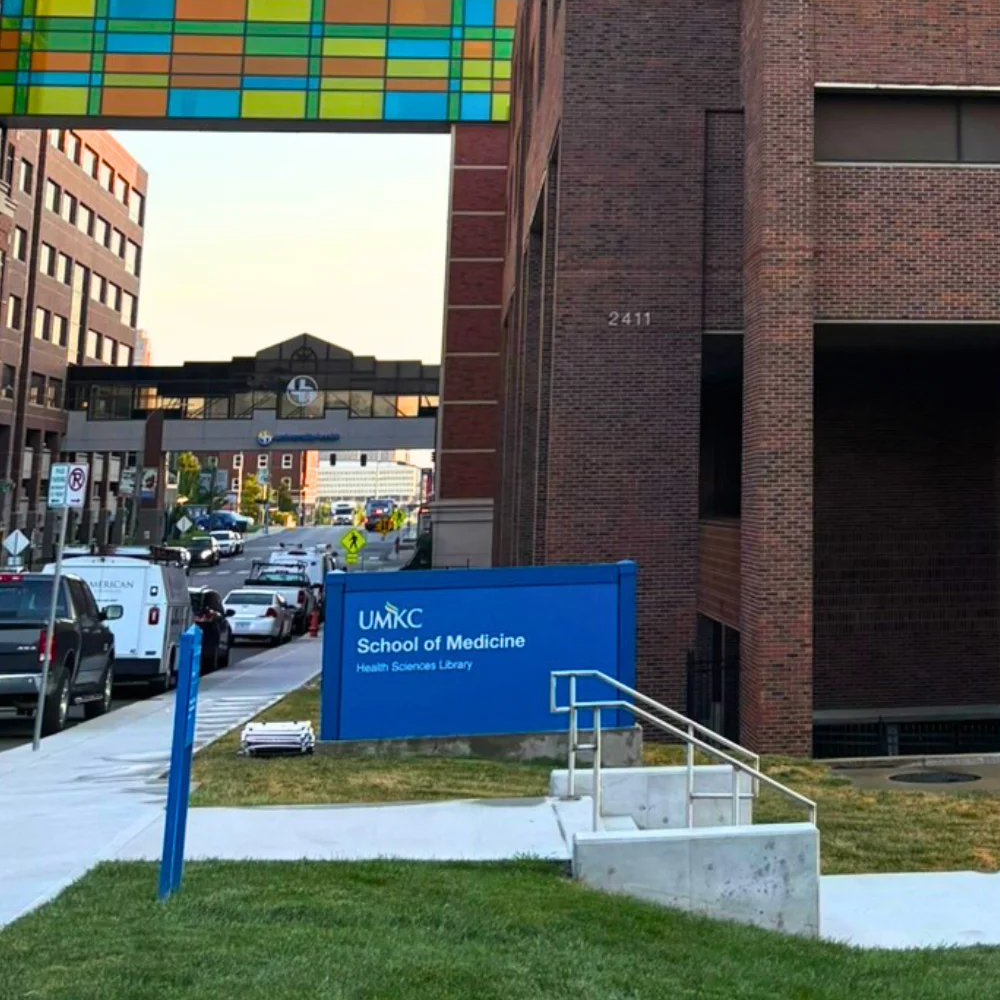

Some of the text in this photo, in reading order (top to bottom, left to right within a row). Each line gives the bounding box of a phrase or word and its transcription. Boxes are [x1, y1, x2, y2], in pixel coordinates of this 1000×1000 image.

[608, 310, 651, 327] 2411
[89, 580, 135, 589] MERICAN
[359, 605, 423, 630] UMKC
[357, 633, 526, 654] School of Medicine
[356, 659, 473, 673] Health Sciences Library
